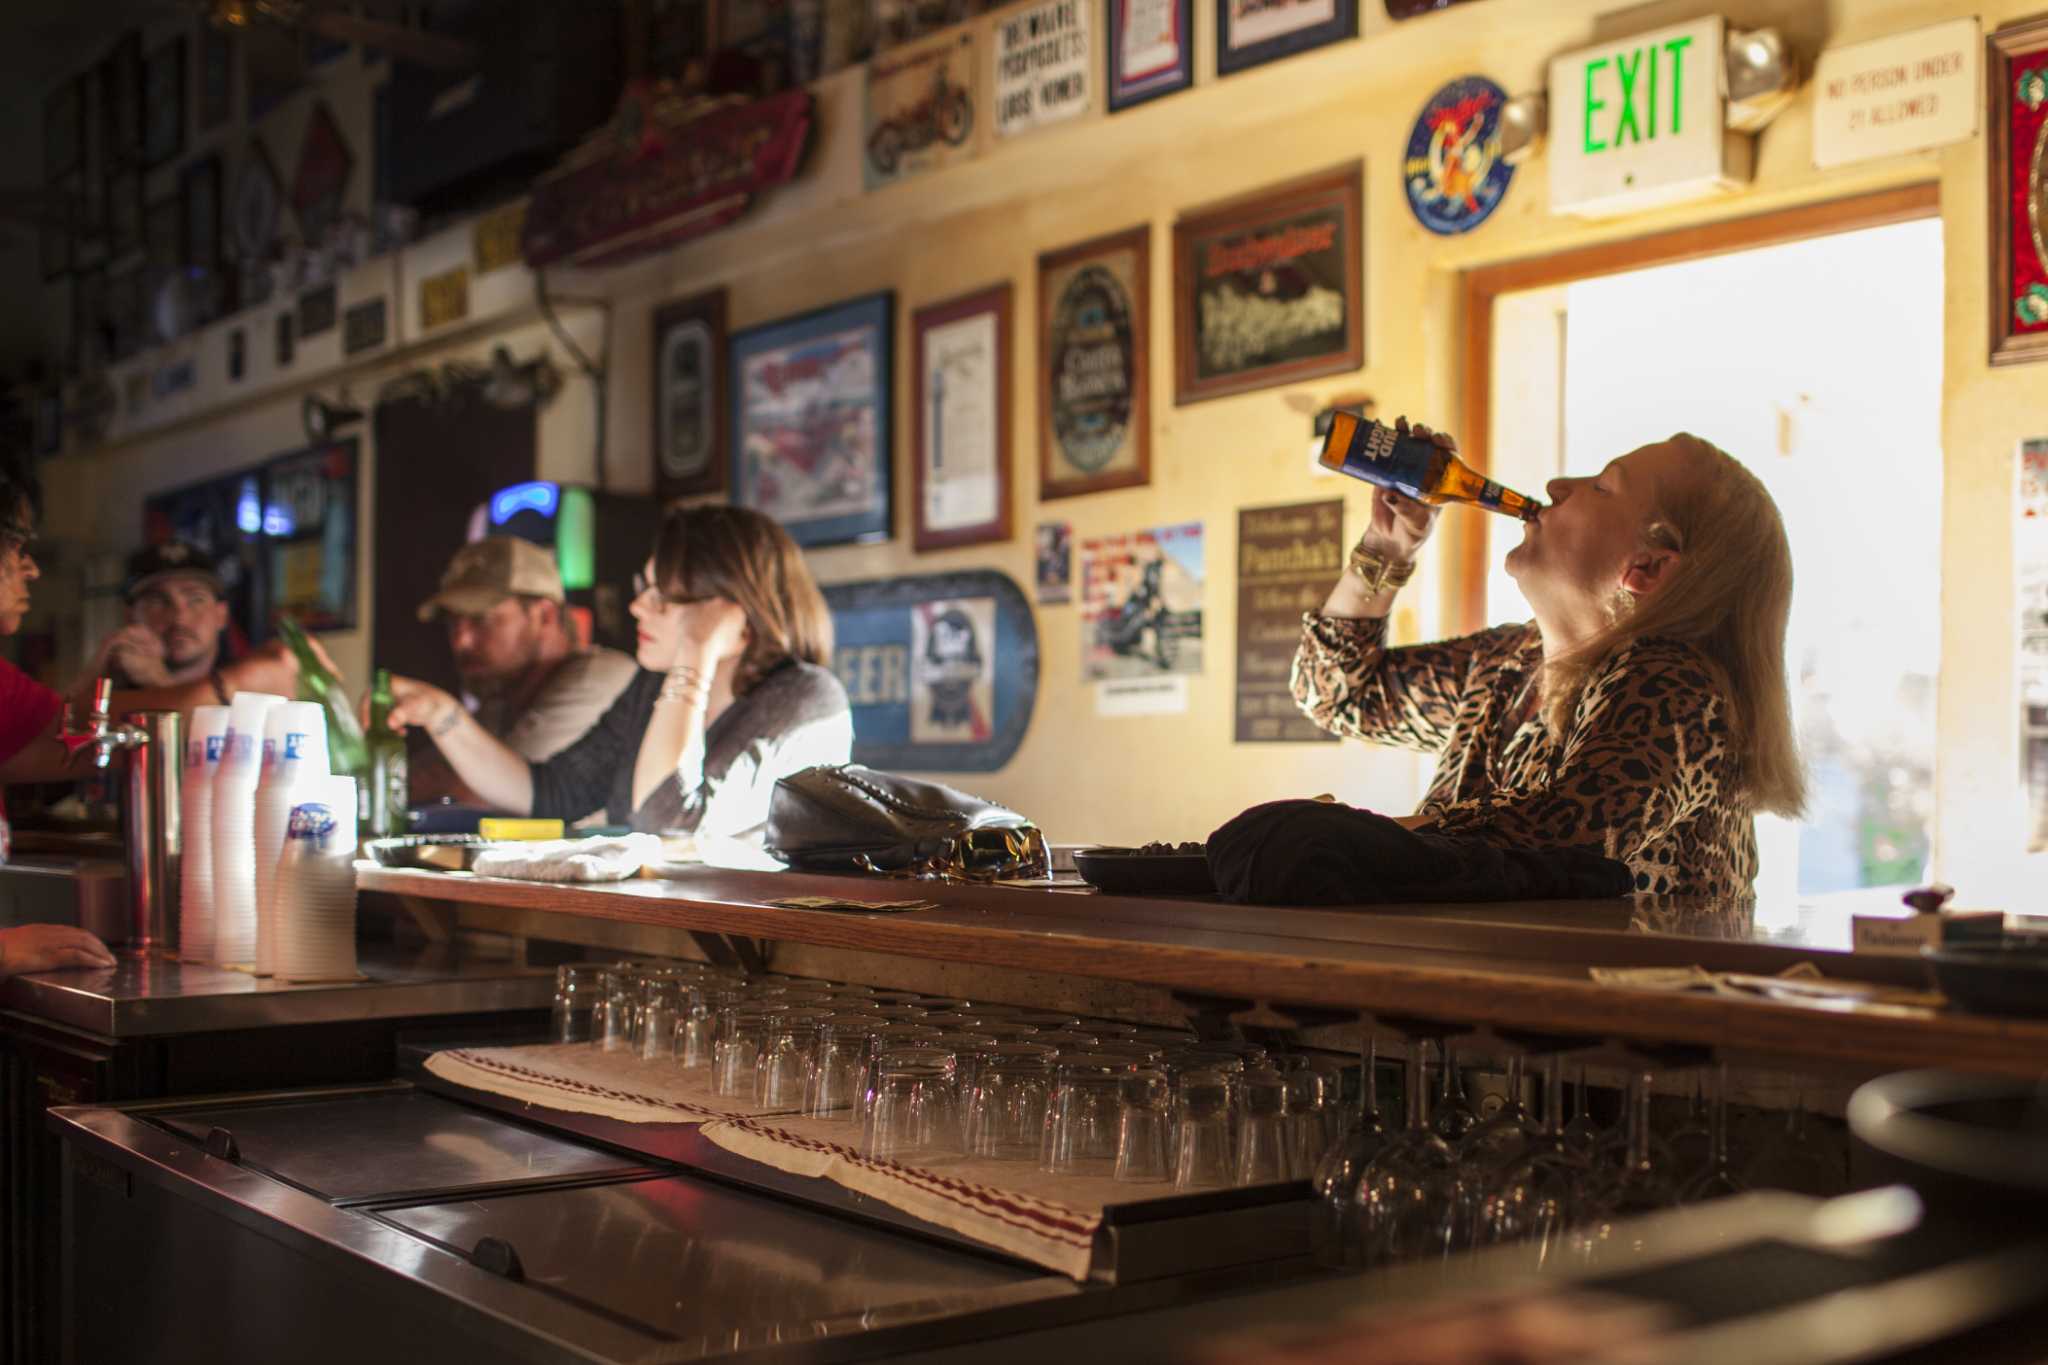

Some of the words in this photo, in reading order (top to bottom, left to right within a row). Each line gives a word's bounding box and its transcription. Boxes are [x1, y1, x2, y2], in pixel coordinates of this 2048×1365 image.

[1584, 36, 1693, 154] EXIT
[1828, 79, 1845, 99] NO
[1851, 65, 1908, 94] PERSON
[1915, 51, 1963, 81] UNDER
[1849, 109, 1865, 131] 21
[1871, 93, 1938, 126] ALLOWED
[834, 644, 909, 705] EER
